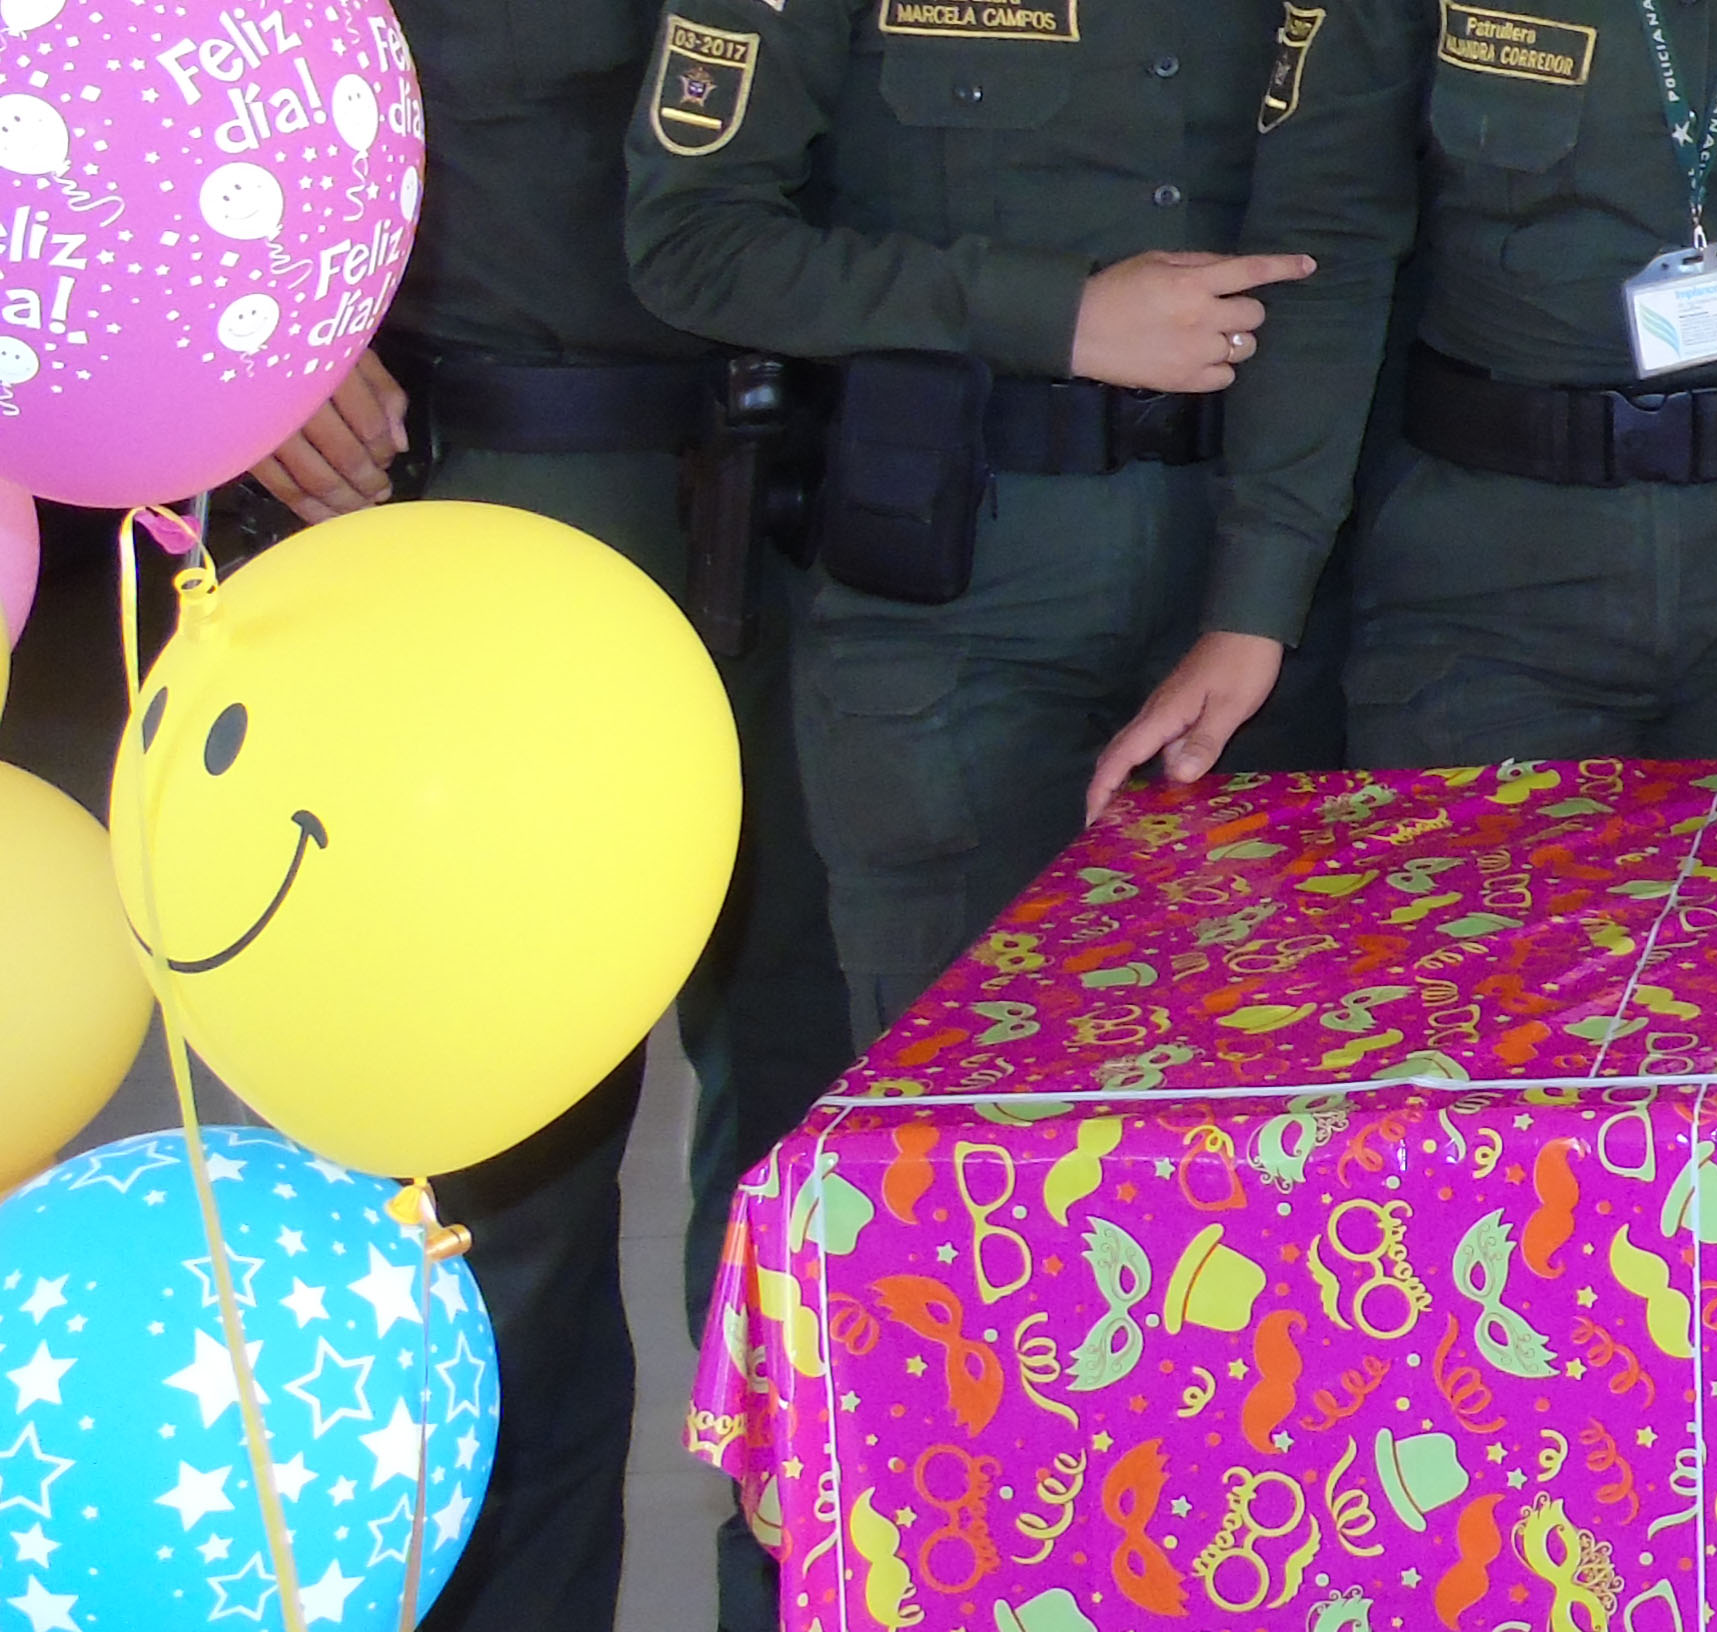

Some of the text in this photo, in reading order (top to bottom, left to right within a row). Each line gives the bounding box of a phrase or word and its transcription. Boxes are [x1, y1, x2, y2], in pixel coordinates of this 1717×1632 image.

[674, 28, 747, 61] 03-2017
[896, 3, 1058, 31] MARCELA CAMPOS
[156, 8, 303, 106] Feliz
[1499, 44, 1575, 77] CORREDOR
[1651, 28, 1681, 103] POLICIA
[213, 57, 328, 154] día!
[0, 205, 88, 271] liz
[314, 218, 404, 301] Feliz
